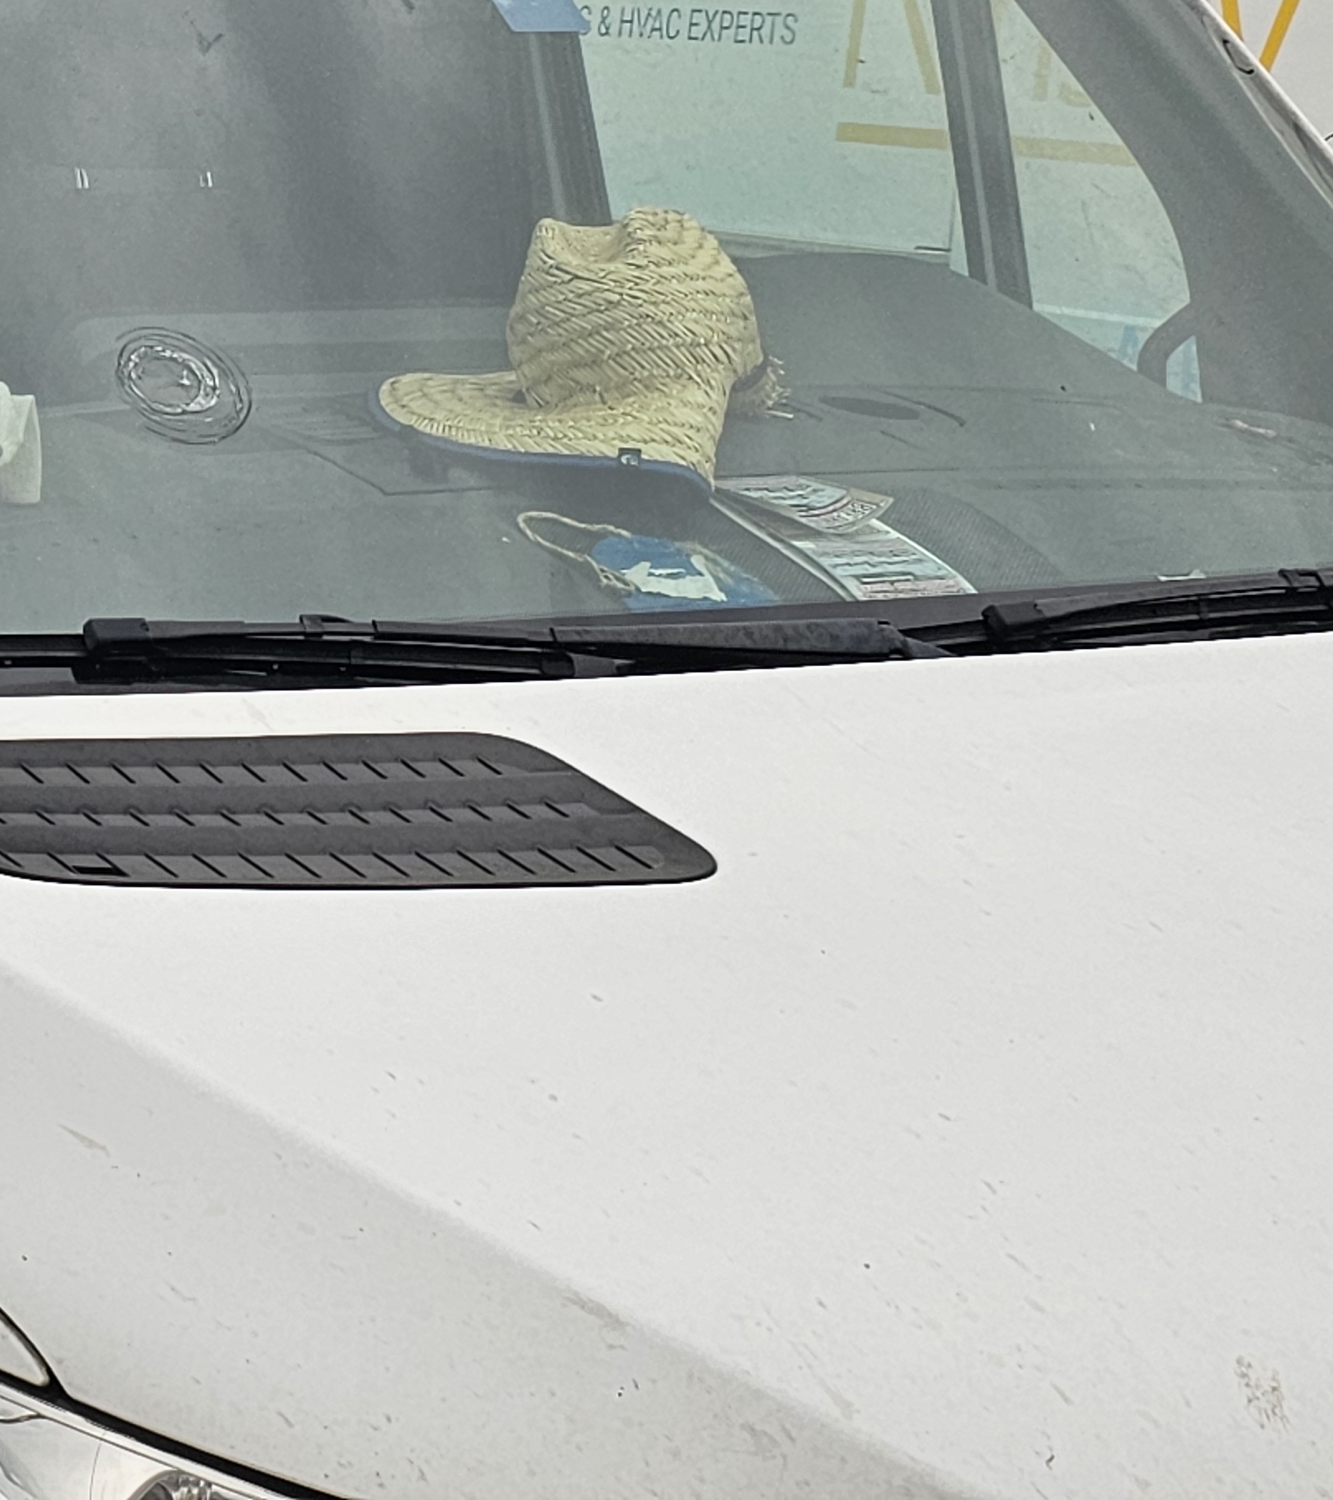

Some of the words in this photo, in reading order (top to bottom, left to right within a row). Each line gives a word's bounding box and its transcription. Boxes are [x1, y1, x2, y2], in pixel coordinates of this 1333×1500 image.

[597, 5, 612, 38] &
[617, 6, 682, 41] HVAC
[686, 8, 799, 46] EXPERTS
